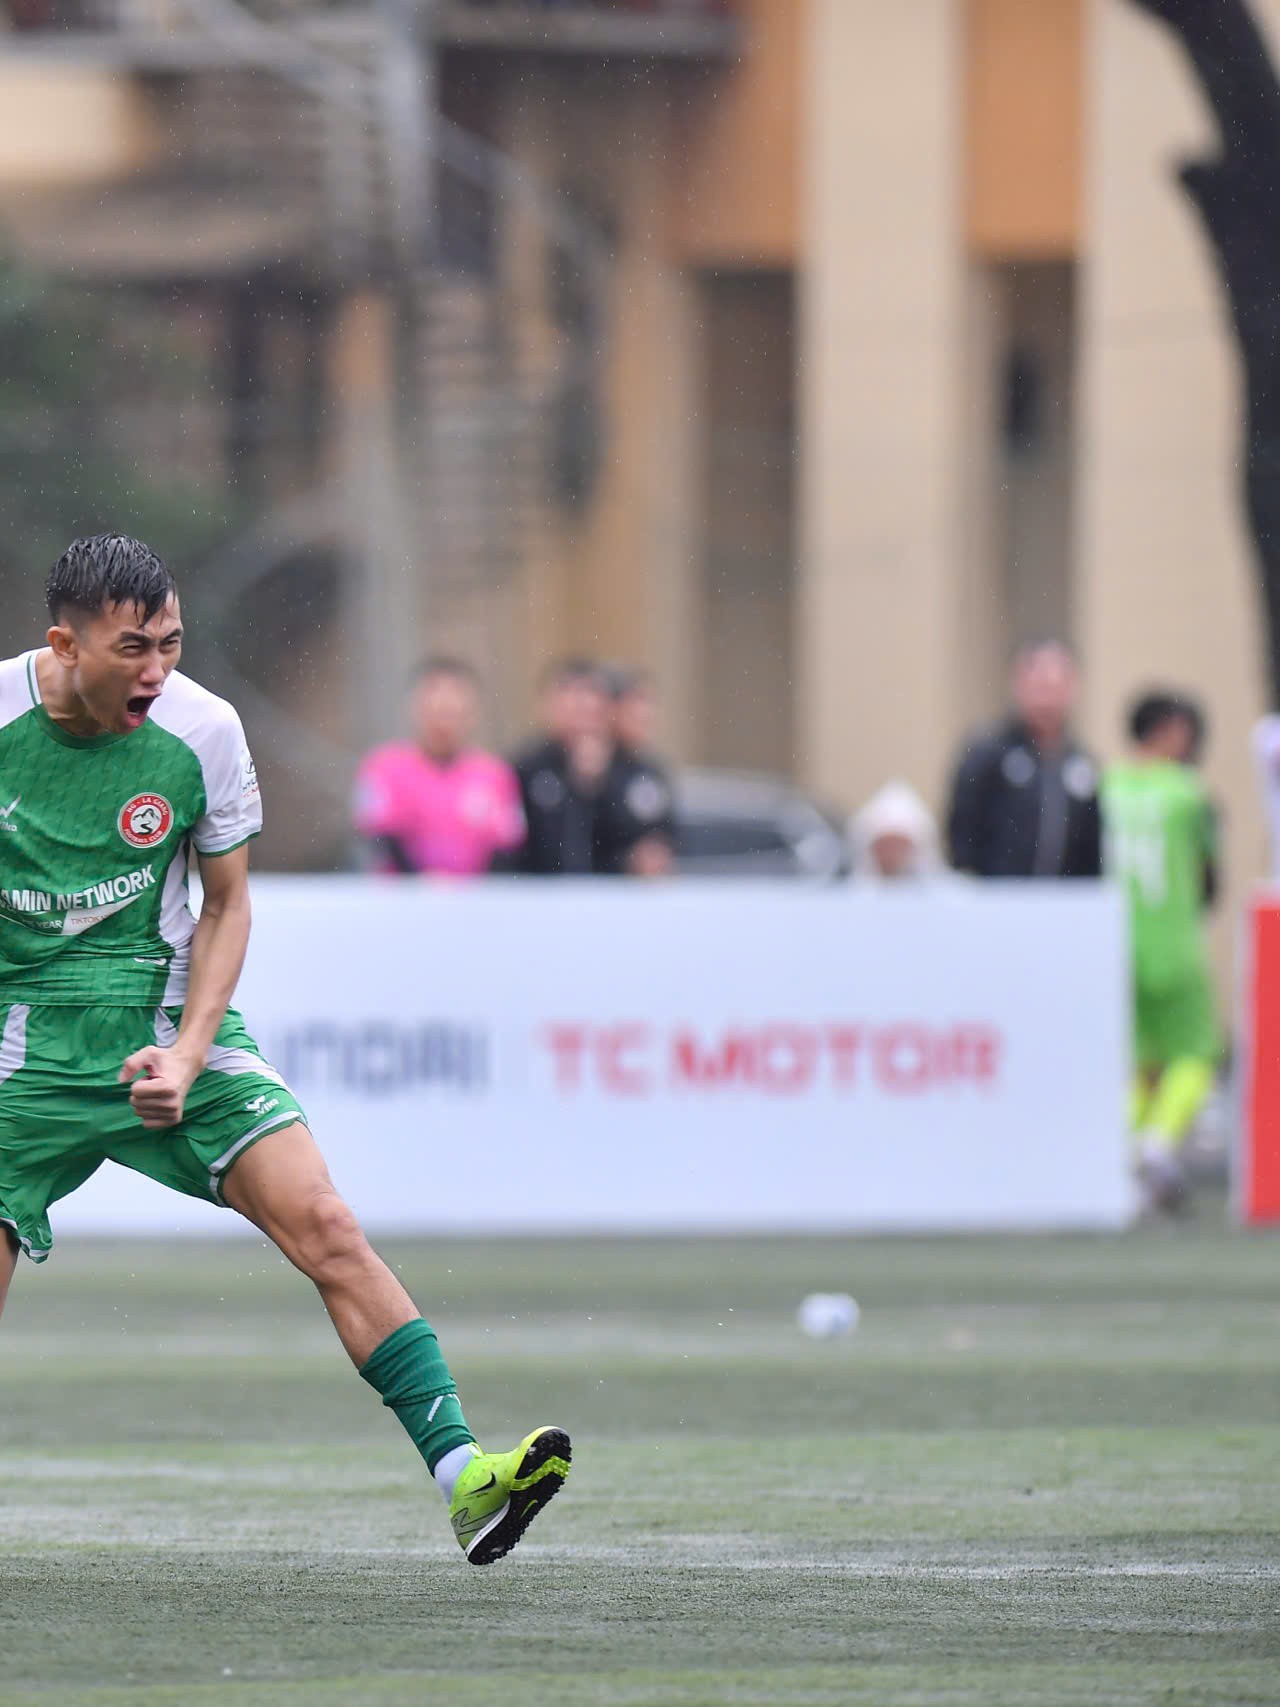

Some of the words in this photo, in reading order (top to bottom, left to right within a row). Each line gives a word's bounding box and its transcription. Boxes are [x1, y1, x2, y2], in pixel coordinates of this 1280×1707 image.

[56, 864, 157, 911] NETWORK
[540, 1020, 656, 1097] TC
[670, 1020, 1002, 1098] MOTOR
